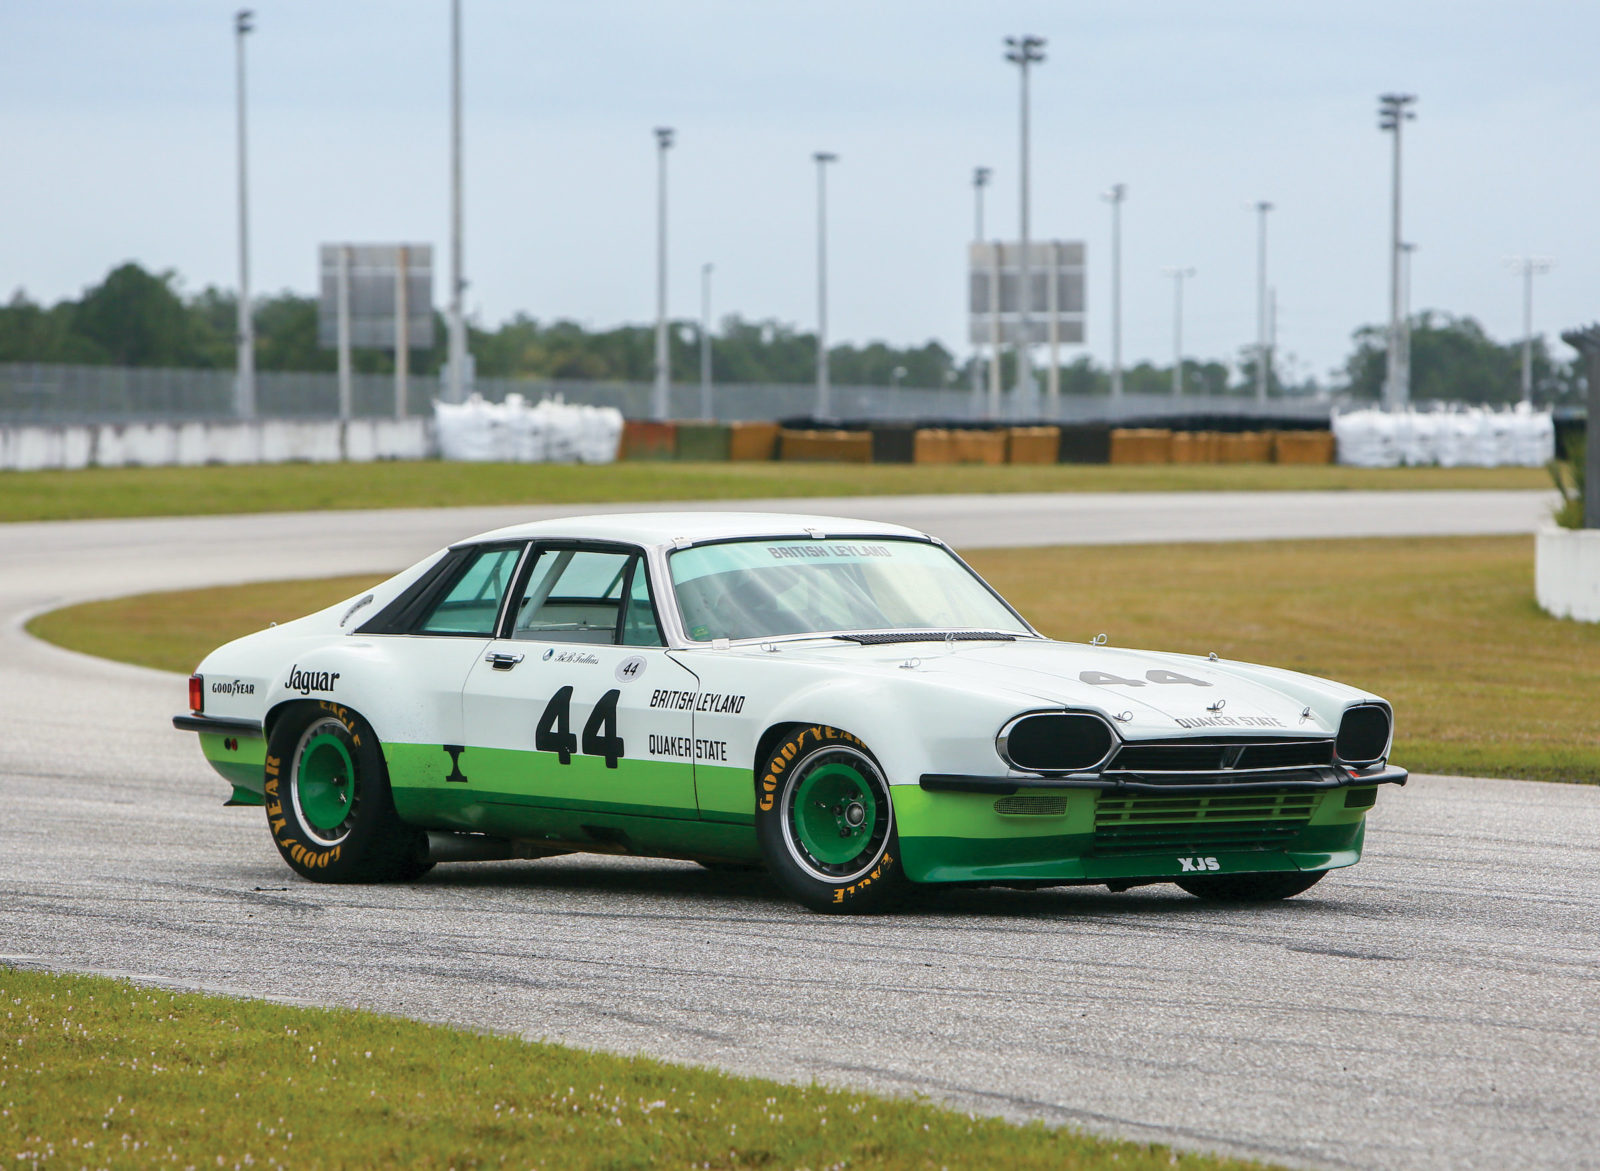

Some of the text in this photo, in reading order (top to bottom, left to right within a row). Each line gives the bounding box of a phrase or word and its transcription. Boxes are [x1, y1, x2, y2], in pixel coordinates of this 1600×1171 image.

[767, 545, 892, 559] BRITISH LEYLAND
[623, 662, 640, 676] 44
[285, 664, 340, 695] Jaguar
[1079, 669, 1214, 687] 44
[212, 679, 255, 696] GOODYEAR
[650, 689, 745, 714] BRITISH LEYLAND
[535, 685, 624, 769] 44
[1174, 716, 1288, 729] QUAKER STATE
[649, 734, 728, 761] QUAKER STATE
[1177, 857, 1221, 872] XJS
